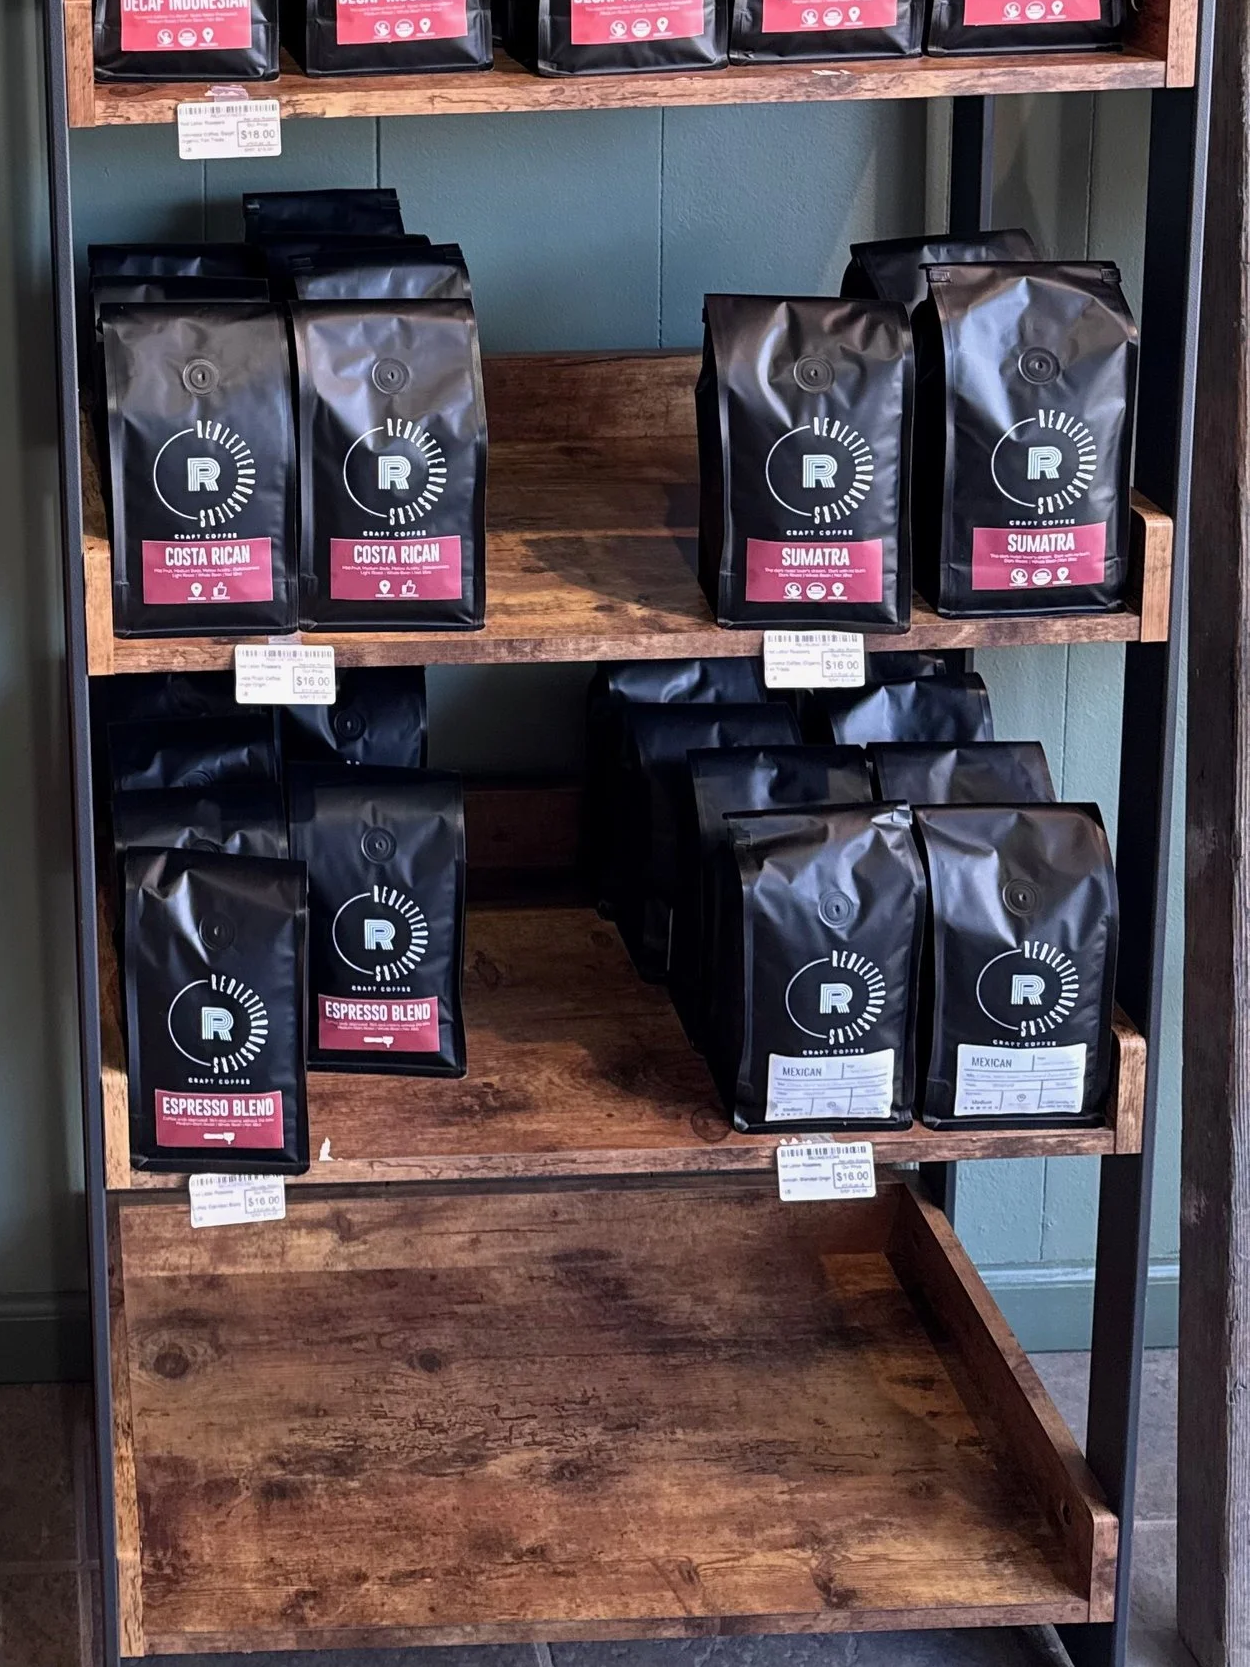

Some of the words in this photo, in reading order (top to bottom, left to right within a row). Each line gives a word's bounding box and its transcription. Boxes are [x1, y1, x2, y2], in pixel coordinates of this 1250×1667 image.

[187, 458, 220, 491] R
[378, 456, 411, 490] R
[803, 455, 837, 488] R
[1027, 446, 1062, 480] R
[166, 547, 207, 566] COSTA
[212, 545, 250, 564] RICAN
[354, 545, 396, 564] COSTA
[401, 543, 440, 563] RICAN
[1008, 533, 1075, 553] SUMATRA
[782, 548, 849, 566] SUMATRA
[364, 919, 395, 950] R
[820, 983, 853, 1014] R
[1011, 975, 1045, 1005] R
[325, 1001, 387, 1021] ESPRESSO
[392, 1003, 430, 1021] BLEND
[202, 1007, 234, 1042] R
[782, 1066, 822, 1077] MEXICAN
[972, 1057, 1012, 1068] MEXICAN
[163, 1097, 228, 1115] ESPRESSO
[233, 1097, 274, 1116] BLEND
